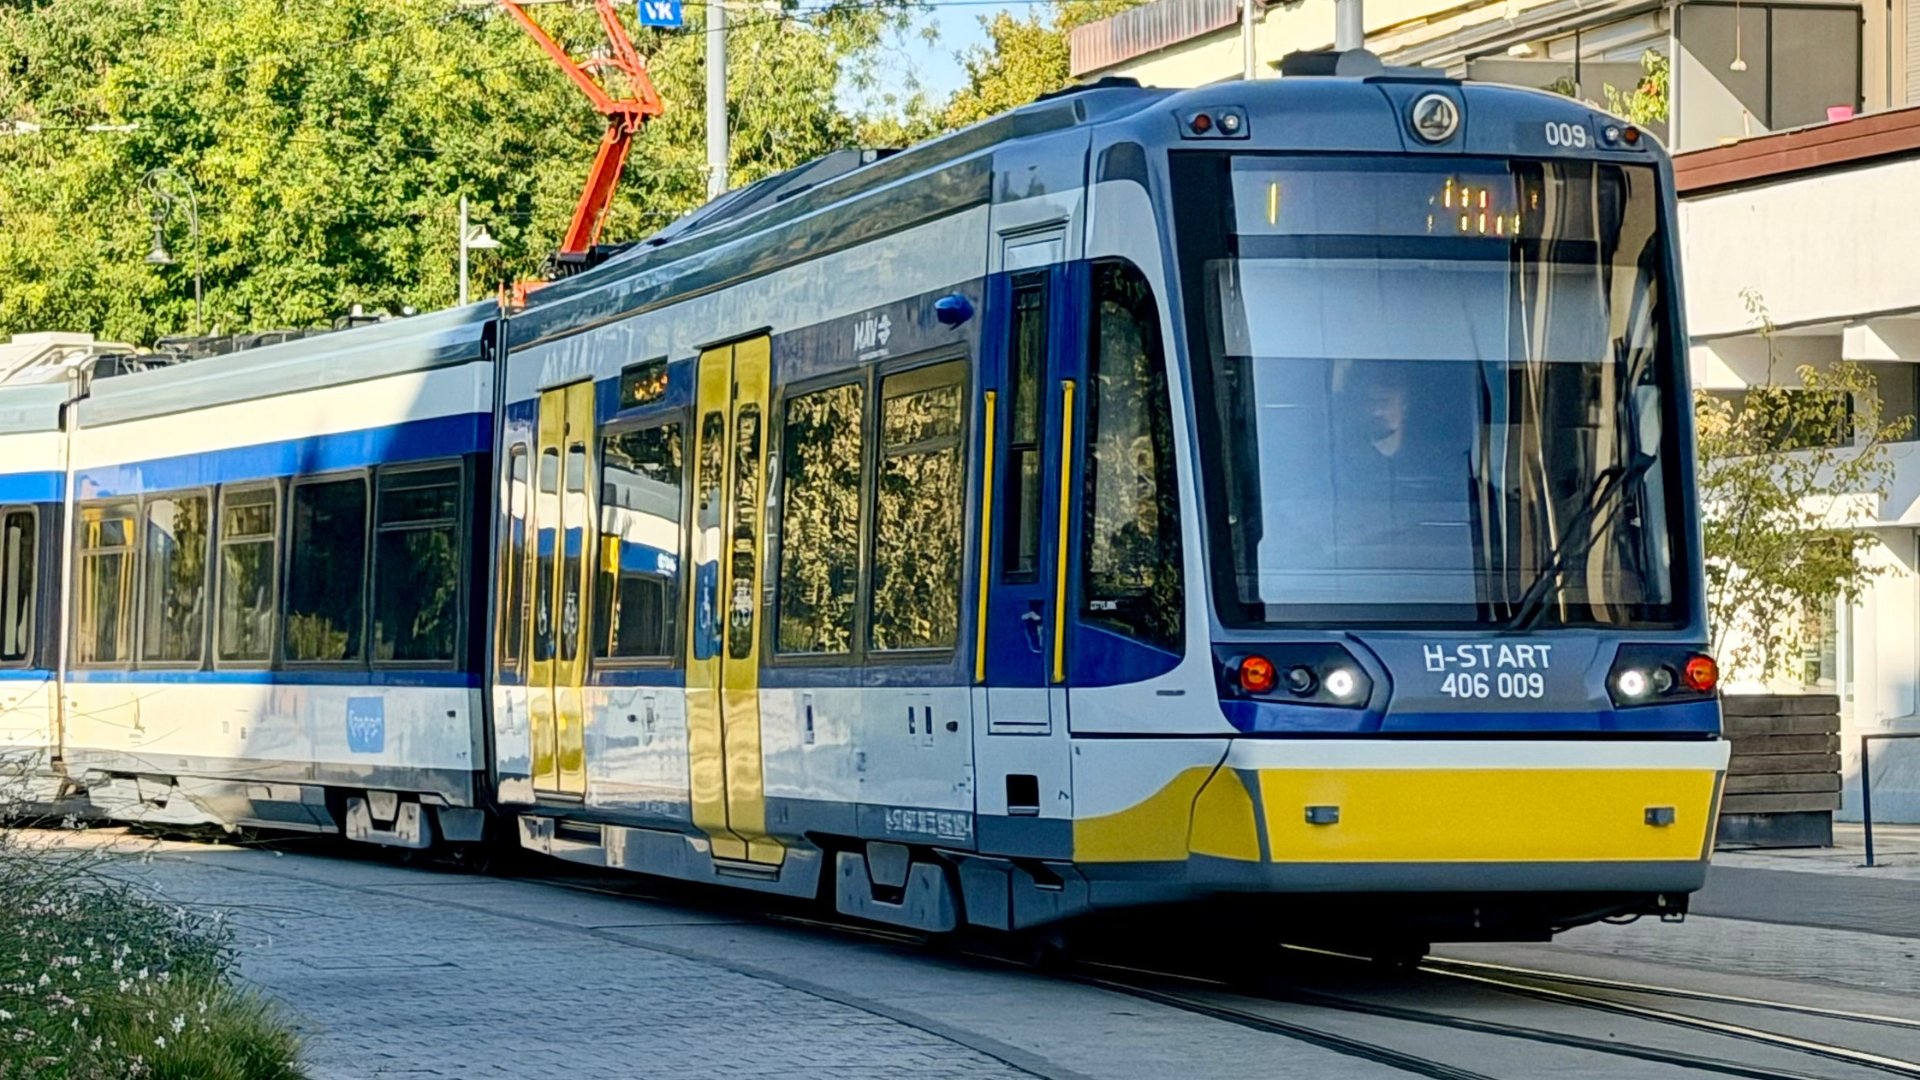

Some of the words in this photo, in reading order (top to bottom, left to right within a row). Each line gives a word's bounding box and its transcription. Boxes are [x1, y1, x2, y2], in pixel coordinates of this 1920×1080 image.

[644, 1, 674, 20] VK
[1545, 121, 1586, 148] 009
[1423, 644, 1552, 671] H-START
[1440, 672, 1490, 698] 406
[1497, 672, 1544, 698] 009
